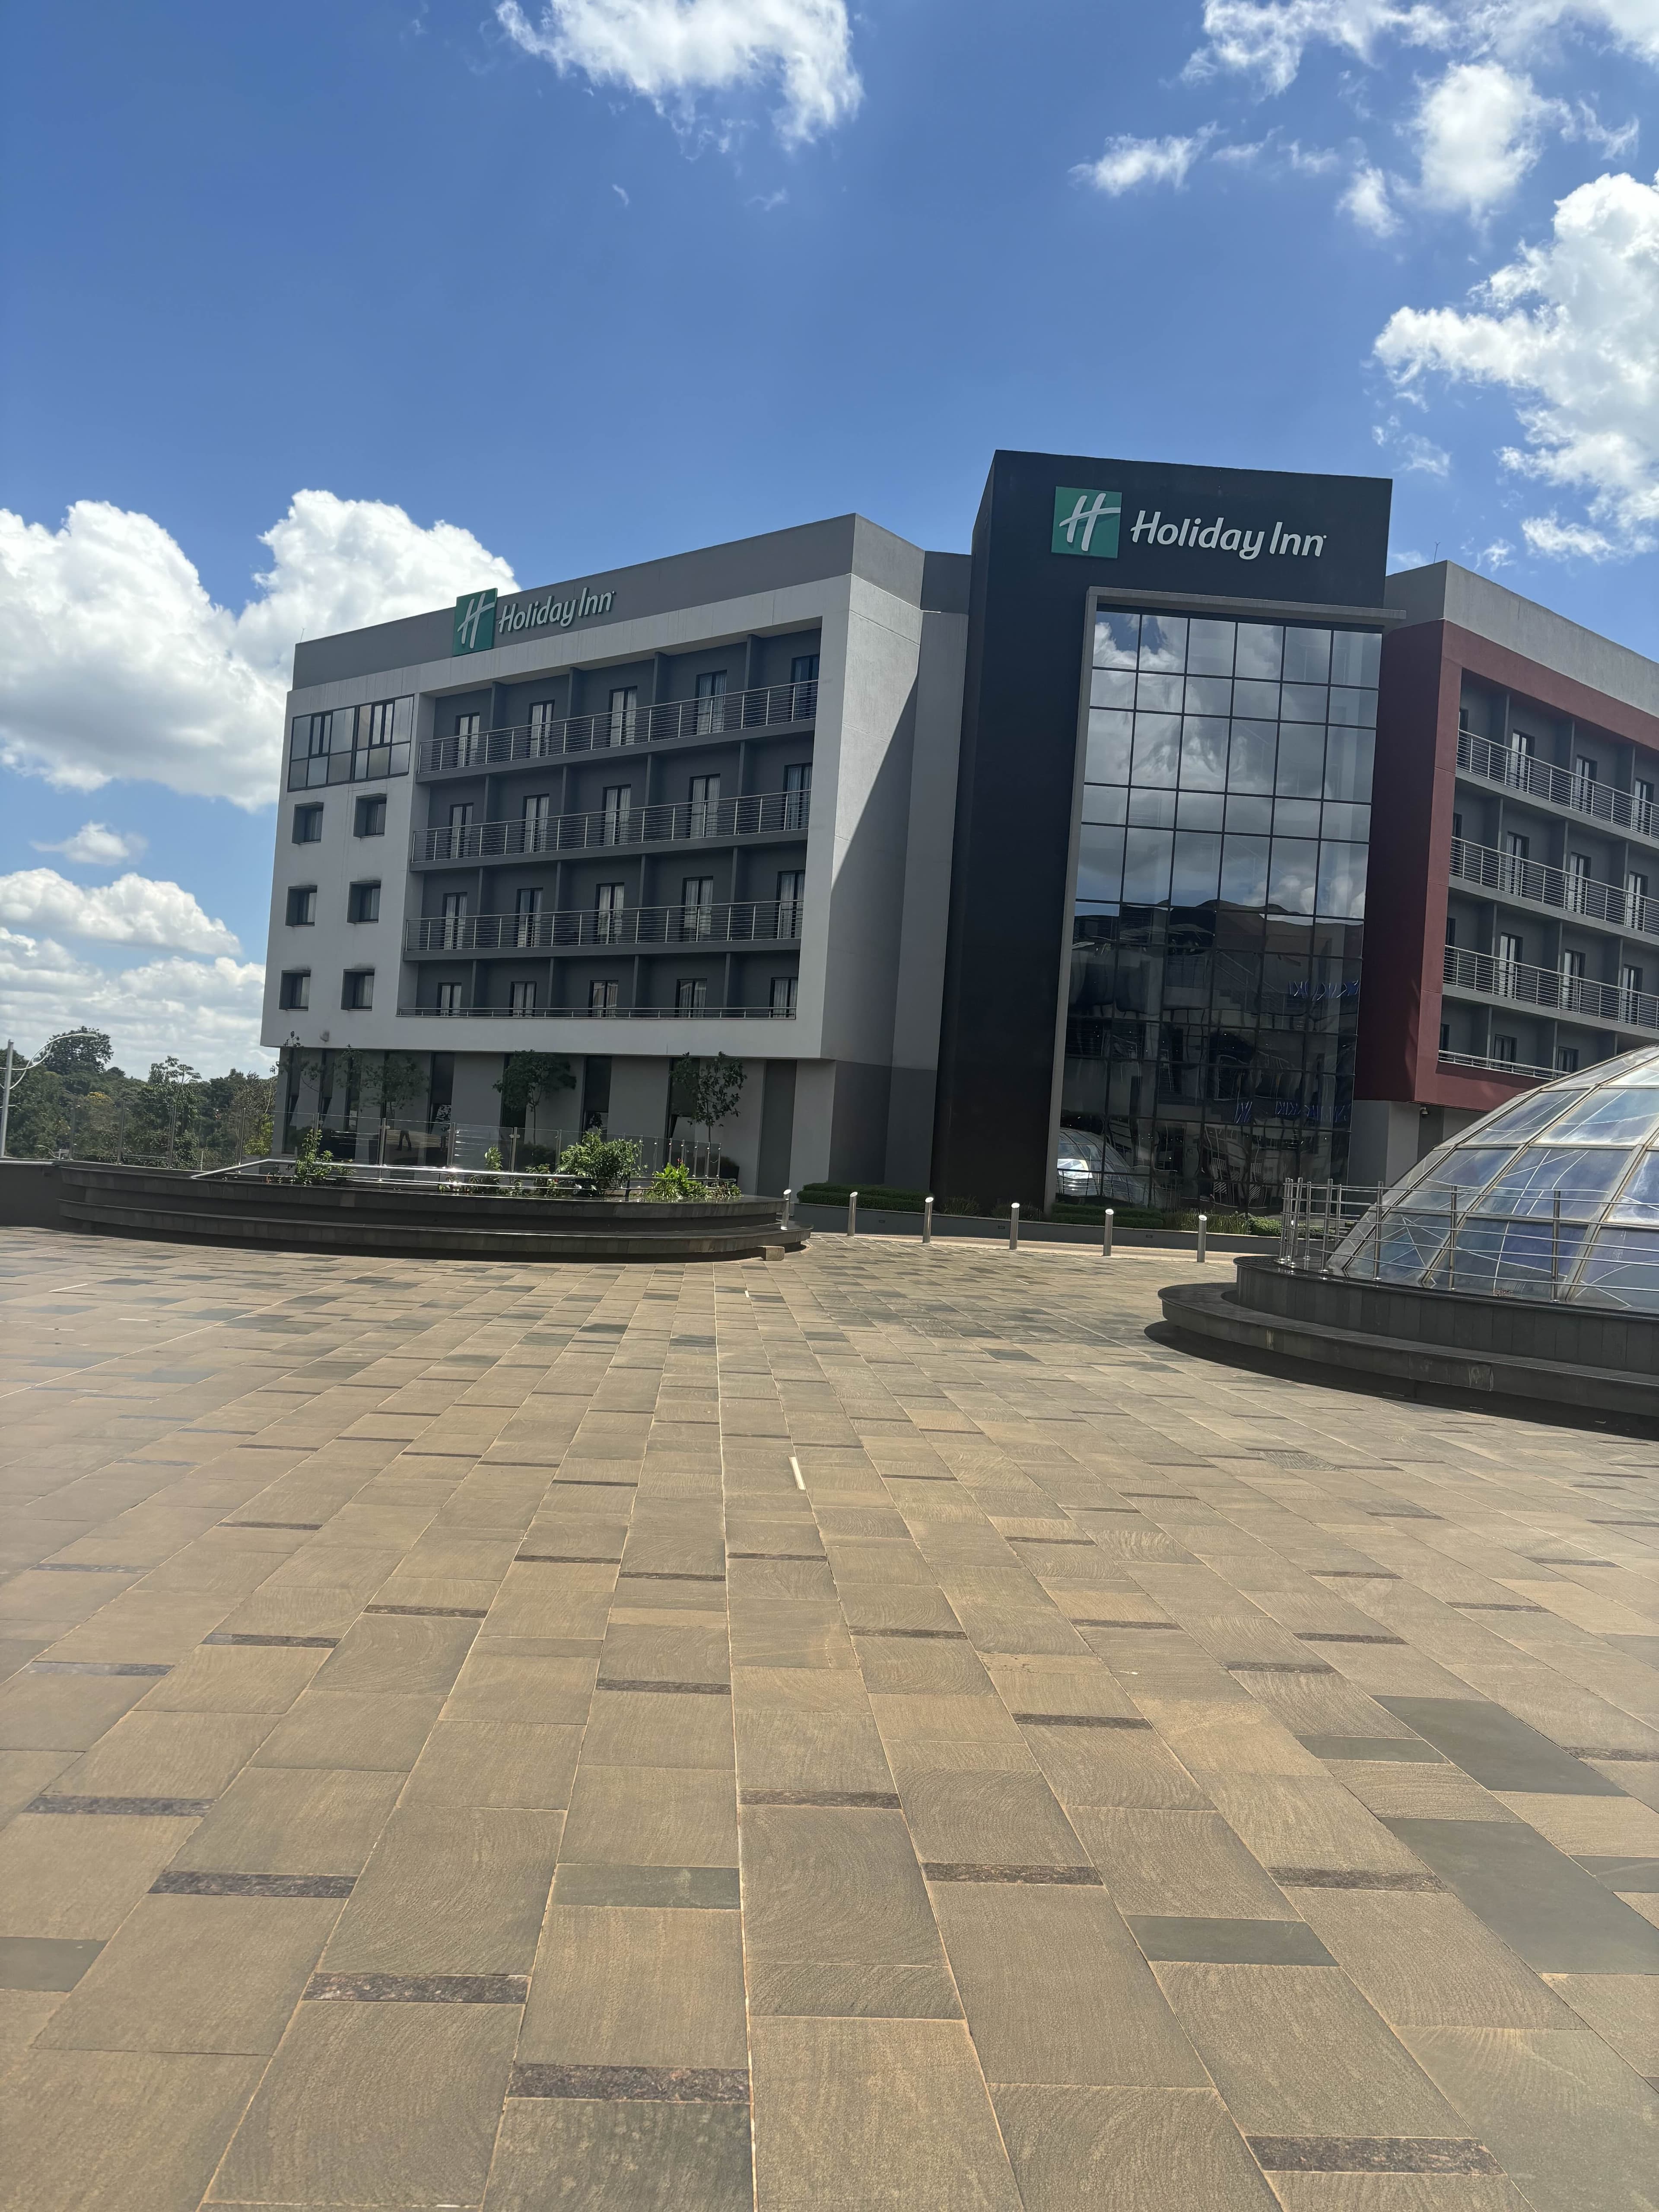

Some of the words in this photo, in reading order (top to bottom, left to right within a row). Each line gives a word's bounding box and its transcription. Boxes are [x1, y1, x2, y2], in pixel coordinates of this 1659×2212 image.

[1131, 510, 1265, 560] Holiday
[1269, 521, 1325, 557] Inn
[498, 595, 576, 633] Holiday
[578, 587, 613, 617] Inn
